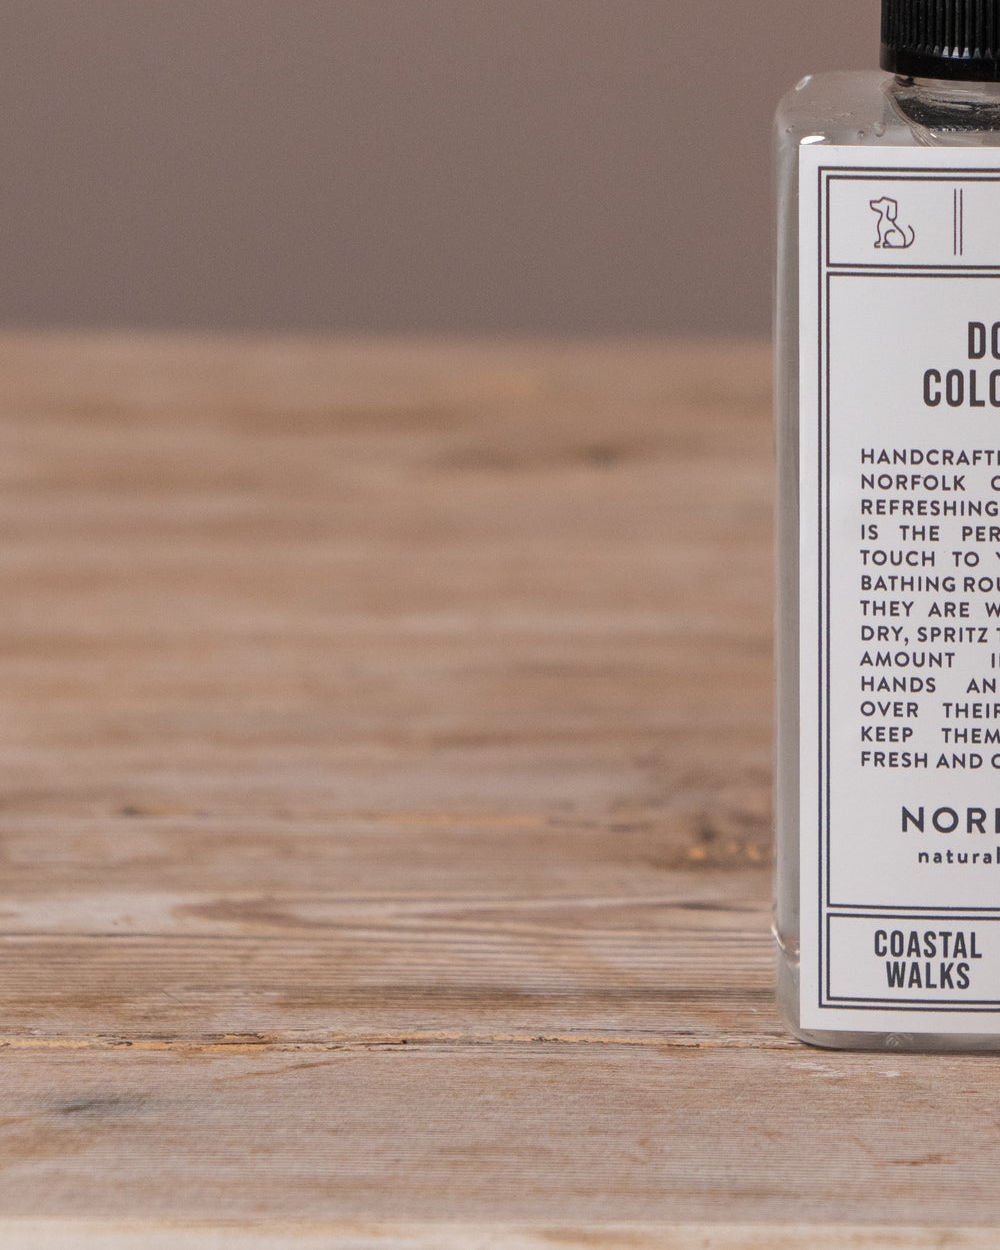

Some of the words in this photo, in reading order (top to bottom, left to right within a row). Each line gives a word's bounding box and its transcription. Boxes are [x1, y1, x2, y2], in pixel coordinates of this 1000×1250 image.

[861, 473, 966, 492] NORFOLK
[861, 498, 999, 517] REFRESHING
[861, 524, 879, 541] IS
[899, 524, 940, 542] THE
[859, 549, 935, 567] TOUCH
[951, 551, 980, 568] TO
[861, 574, 956, 593] BATHING
[859, 599, 915, 617] THEY
[927, 601, 970, 618] ARE
[861, 625, 909, 647] DRY,
[917, 626, 988, 644] SPRITZ
[859, 650, 956, 668] AMOUNT
[861, 675, 936, 694] HANDS
[860, 700, 919, 718] OVER
[861, 725, 914, 743] KEEP
[861, 750, 928, 769] FRESH
[935, 753, 984, 770] AND
[918, 845, 1000, 865] natural
[874, 929, 983, 959] COASTAL
[885, 960, 970, 990] WALKS
